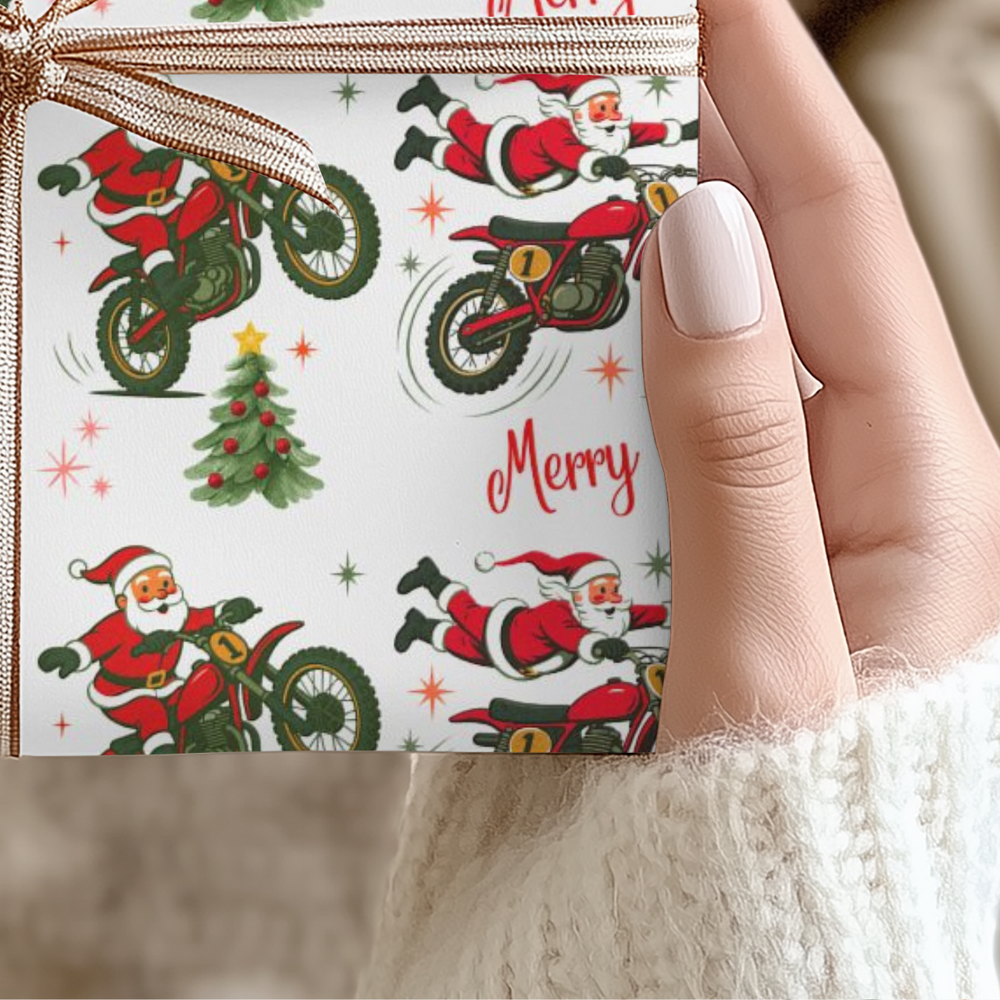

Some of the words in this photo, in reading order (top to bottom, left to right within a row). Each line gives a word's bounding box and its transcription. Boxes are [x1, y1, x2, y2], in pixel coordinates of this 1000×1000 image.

[522, 250, 535, 277] 1
[487, 417, 640, 517] Merry
[218, 635, 243, 659] 1
